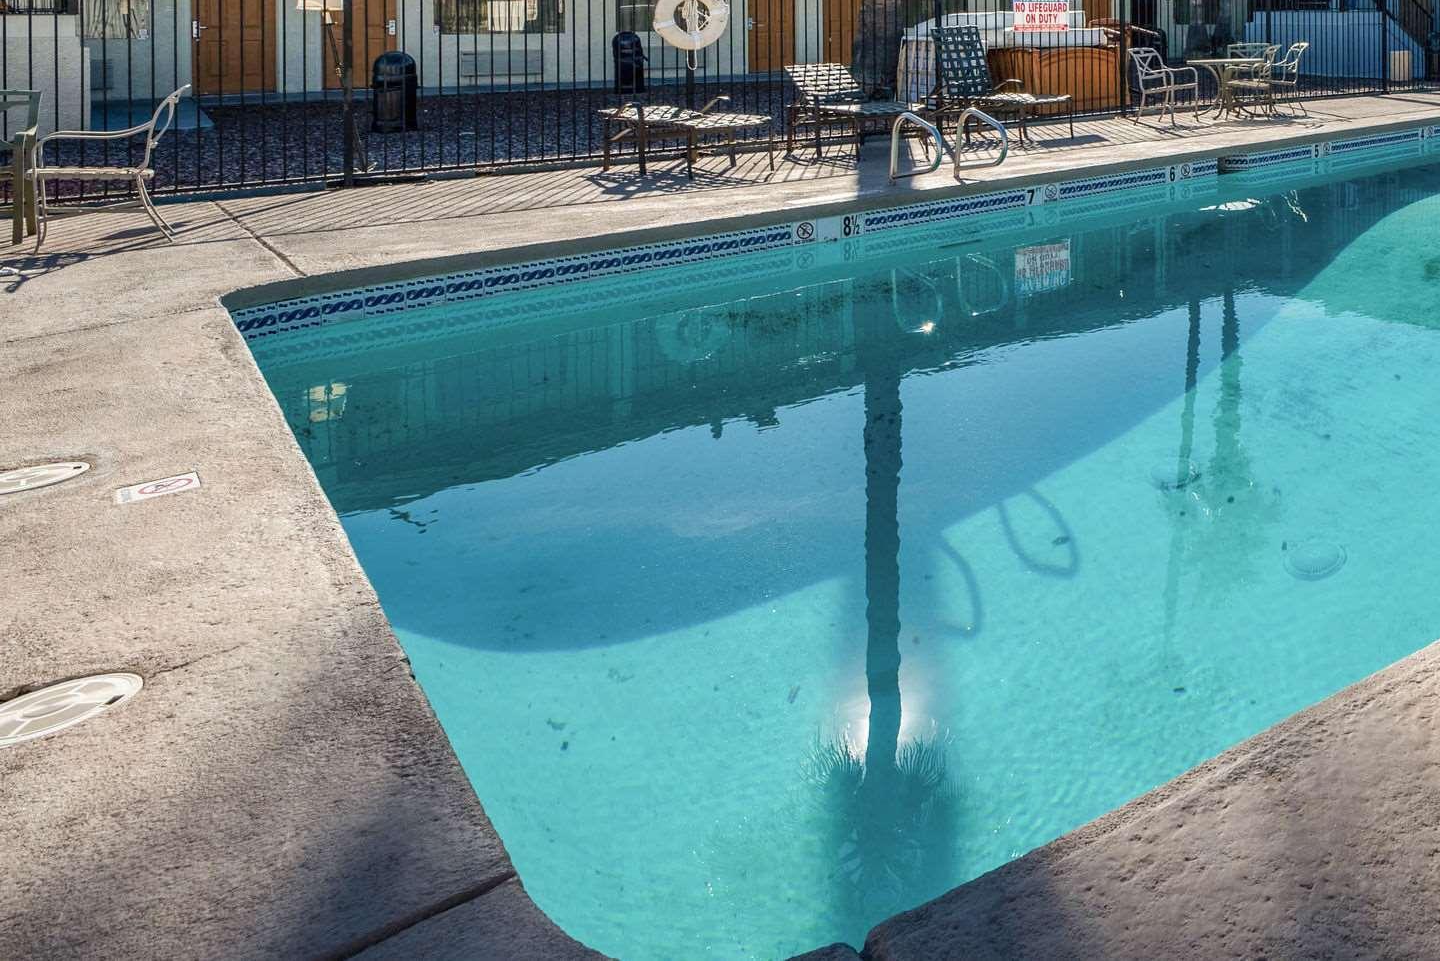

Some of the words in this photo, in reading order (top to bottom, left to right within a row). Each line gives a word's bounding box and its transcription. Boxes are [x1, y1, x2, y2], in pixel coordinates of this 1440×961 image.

[1015, 3, 1026, 12] NO
[1028, 3, 1067, 12] LIFEGUARD
[1025, 14, 1036, 23] ON
[1038, 14, 1057, 23] DUTY
[1314, 144, 1319, 158] 5
[1169, 166, 1175, 181] 6
